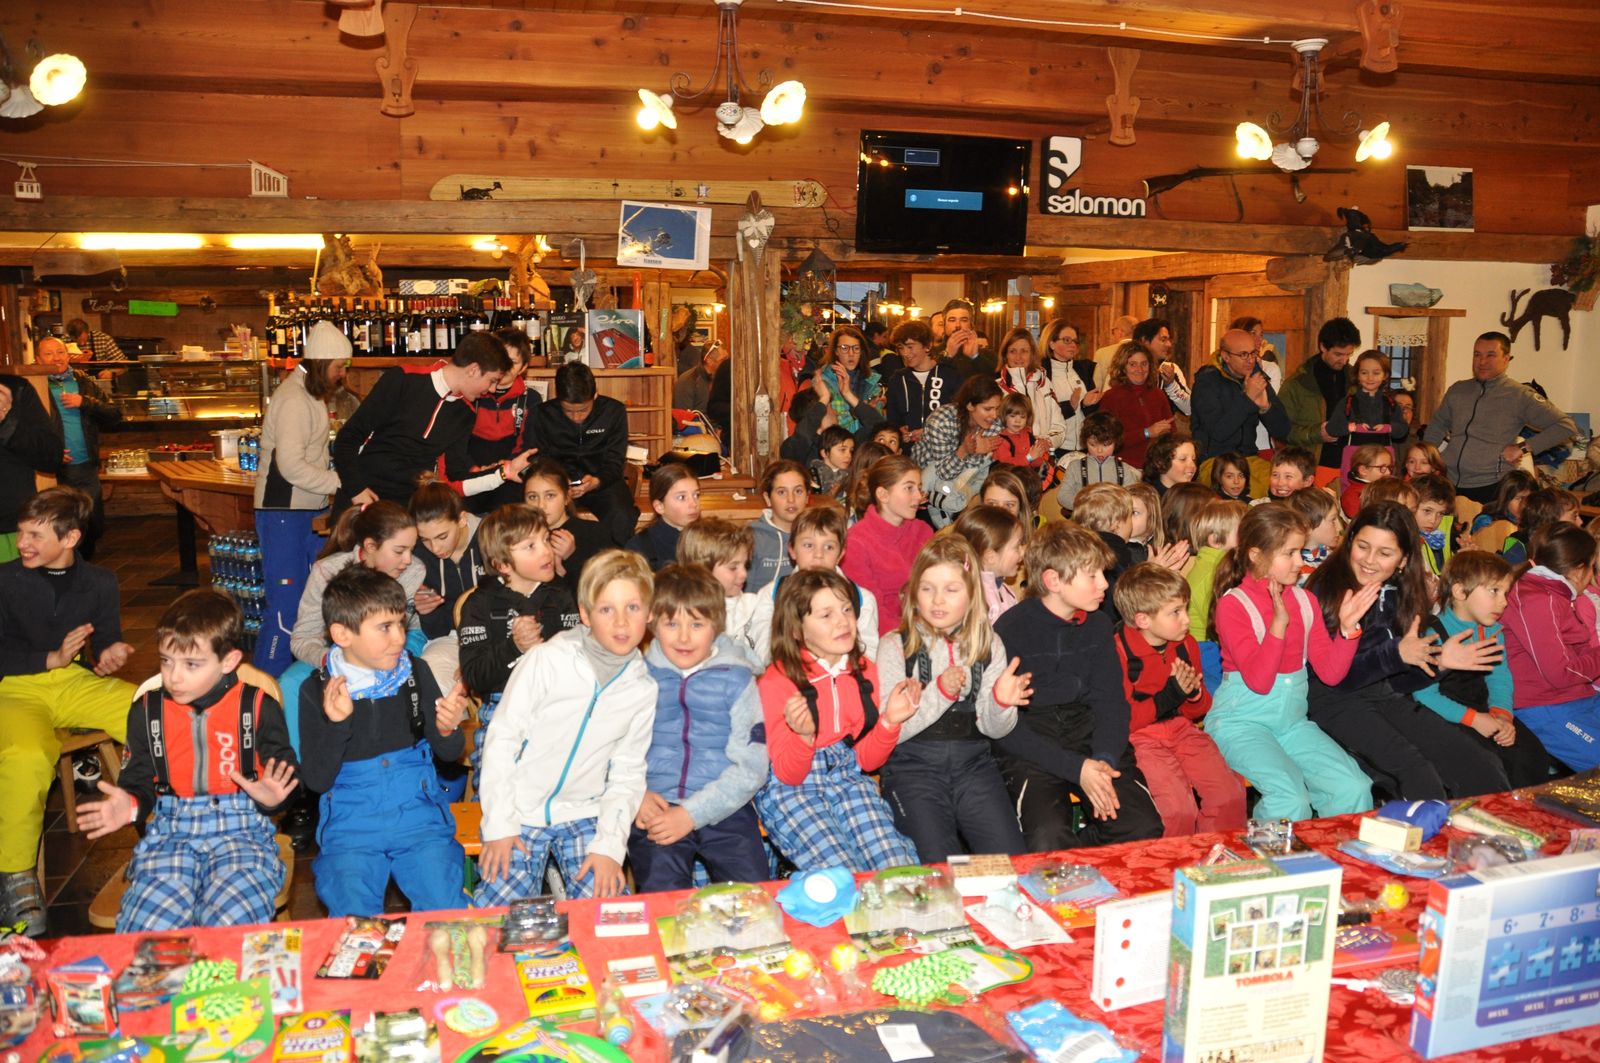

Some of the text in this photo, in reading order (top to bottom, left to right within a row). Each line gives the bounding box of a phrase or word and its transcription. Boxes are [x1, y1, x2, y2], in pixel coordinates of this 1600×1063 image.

[1048, 189, 1146, 216] salomon
[1565, 721, 1595, 743] GORE-TEX
[215, 731, 237, 776] poc
[1503, 918, 1519, 934] 6+
[1540, 912, 1554, 929] 7+
[1236, 970, 1294, 988] TOMBOLA
